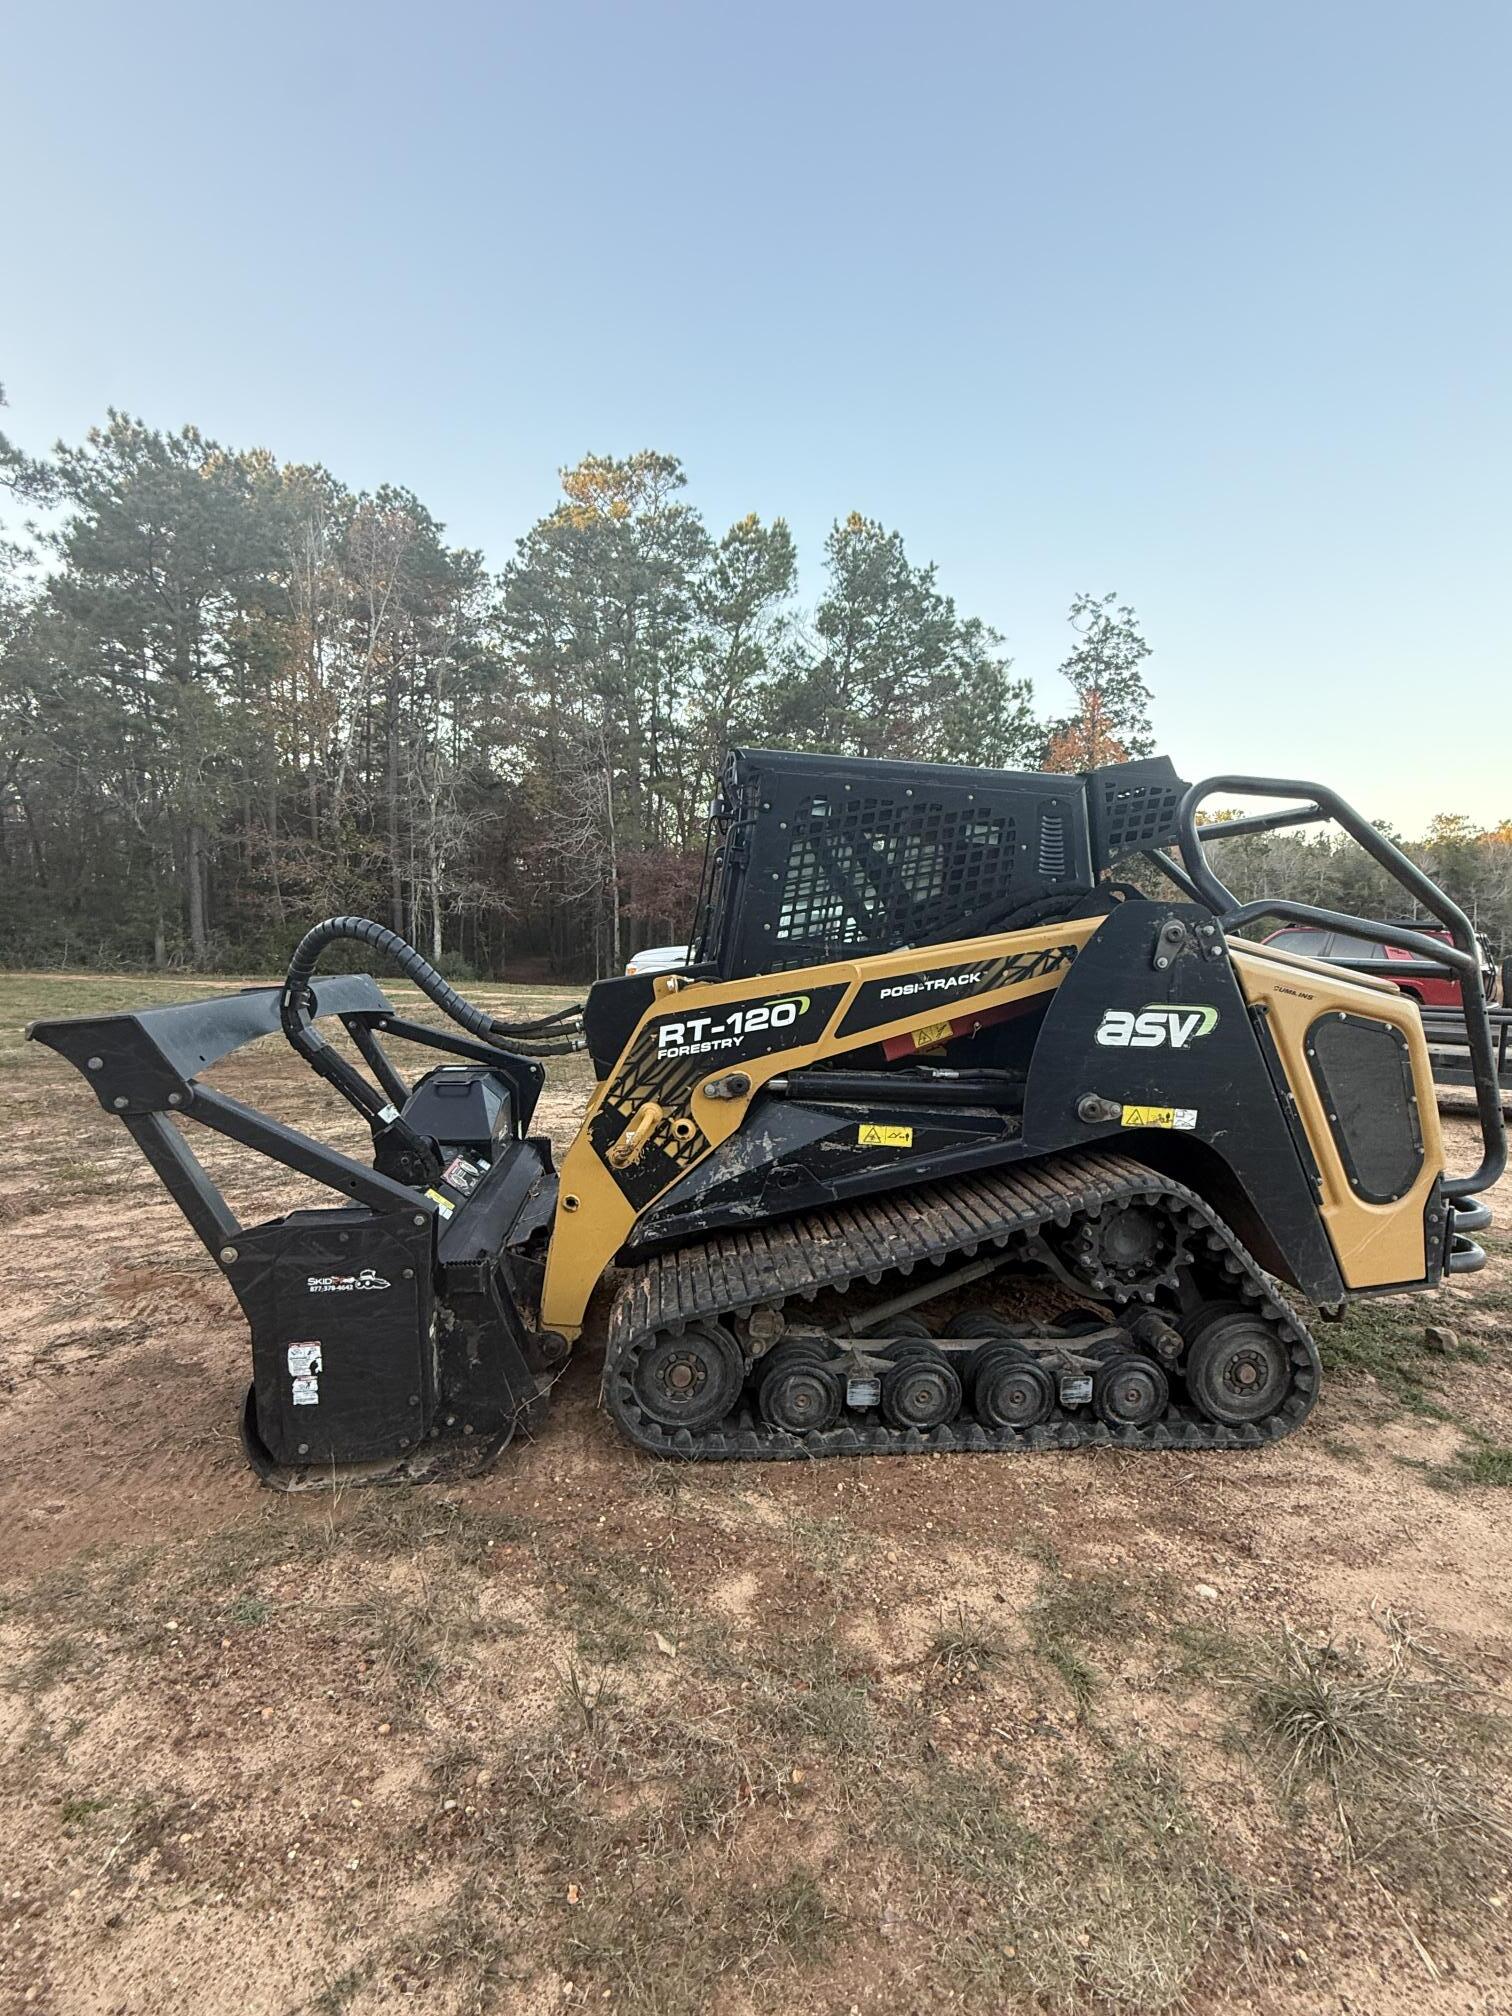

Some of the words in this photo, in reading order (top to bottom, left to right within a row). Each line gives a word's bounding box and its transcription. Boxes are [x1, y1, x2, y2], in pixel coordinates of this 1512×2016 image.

[880, 972, 981, 999] POSI-TRACK
[658, 1003, 797, 1048] RT-120
[657, 1036, 744, 1060] FORESTRY
